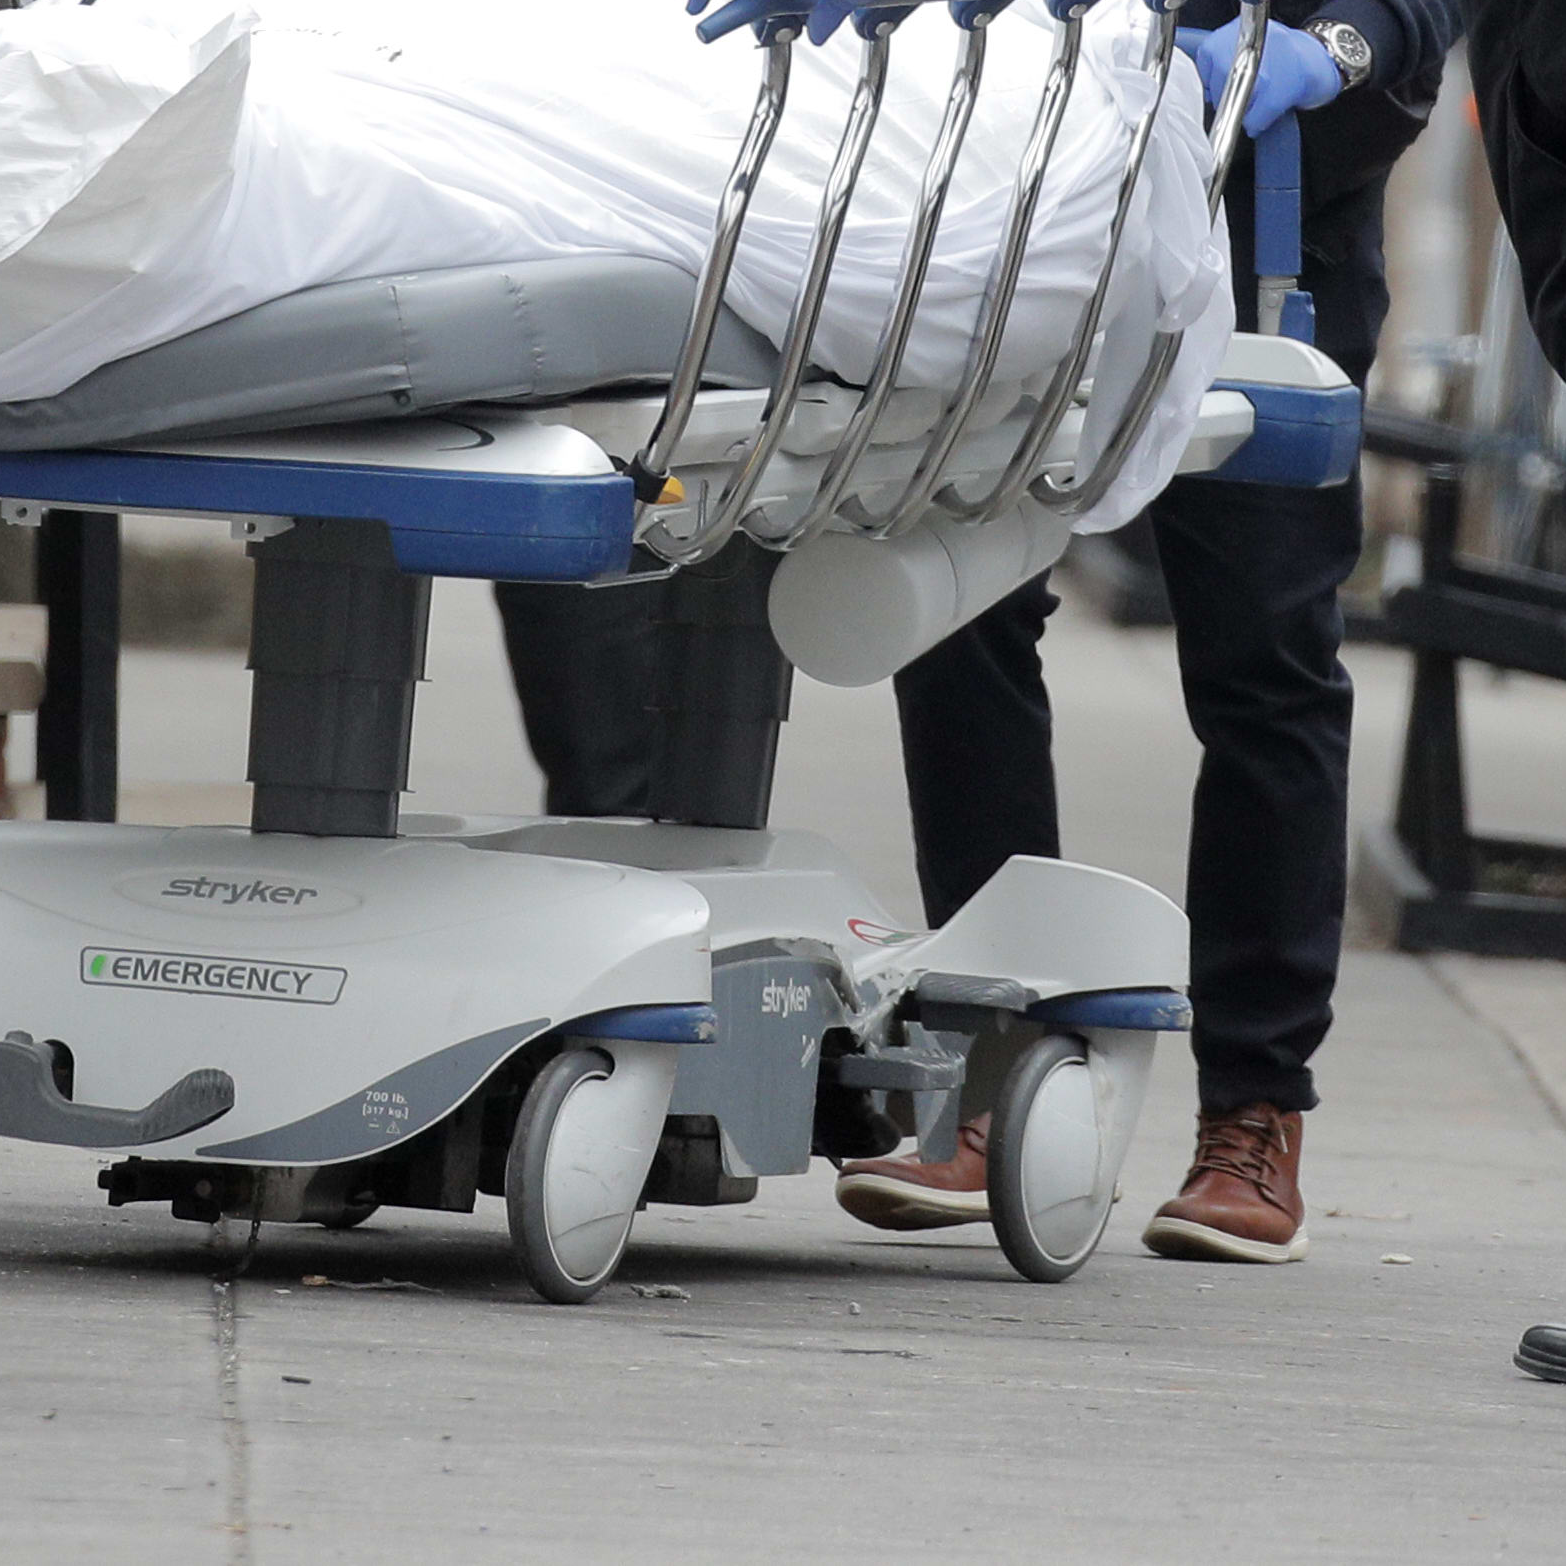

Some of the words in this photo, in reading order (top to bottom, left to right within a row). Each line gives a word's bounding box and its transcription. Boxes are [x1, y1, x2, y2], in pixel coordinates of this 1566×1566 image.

[161, 877, 317, 905] stryker
[112, 956, 313, 995] EMERGENCY
[761, 977, 812, 1019] stryker
[365, 1091, 388, 1103] 700
